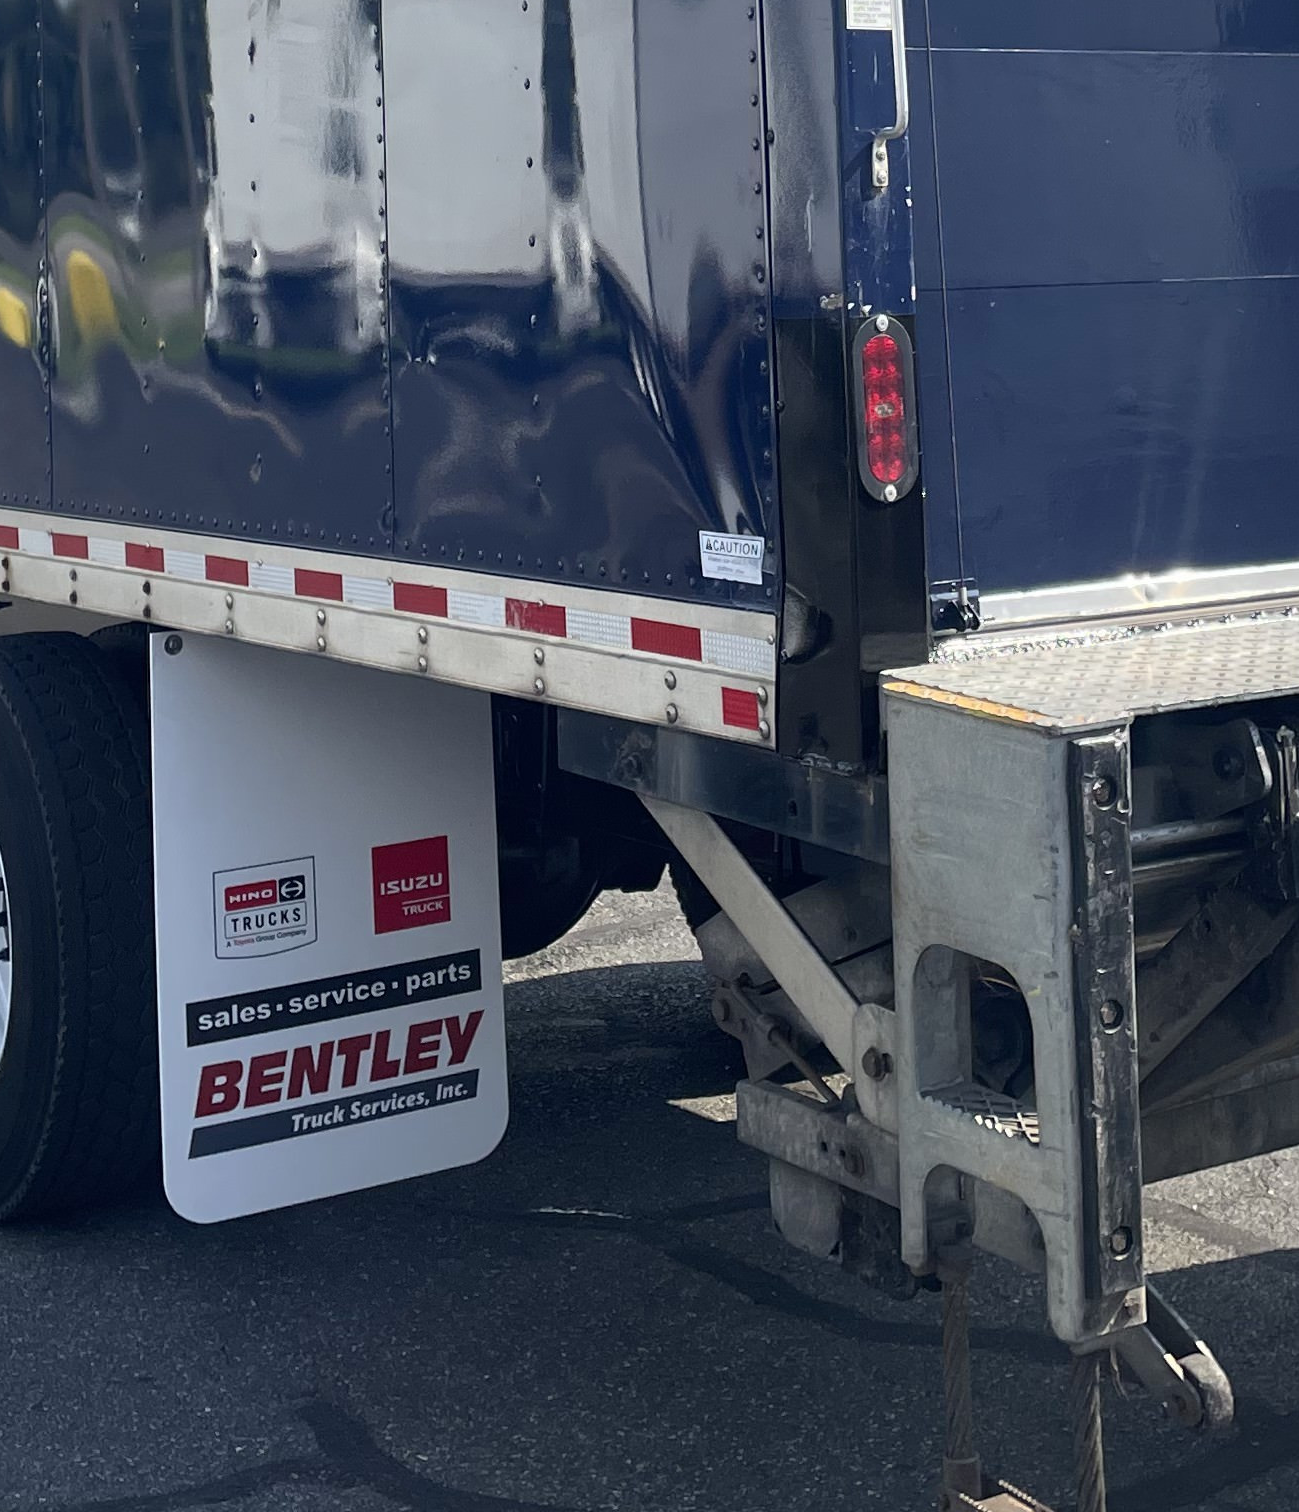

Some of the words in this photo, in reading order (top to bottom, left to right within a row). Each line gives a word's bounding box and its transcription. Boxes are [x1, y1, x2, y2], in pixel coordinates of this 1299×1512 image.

[712, 539, 758, 556] CAUTION
[229, 888, 273, 904] HINO
[380, 872, 443, 896] ISUZU
[230, 907, 301, 933] TRUCKS
[402, 900, 444, 916] TRUCK
[256, 933, 276, 943] Group
[276, 929, 307, 940] Company
[198, 1002, 271, 1031] sales
[288, 982, 385, 1014] service
[406, 962, 472, 996] parts
[194, 1009, 485, 1119] BENTLEY
[291, 1104, 345, 1133] Truck
[350, 1091, 431, 1120] Services,
[435, 1082, 468, 1102] Inc.
